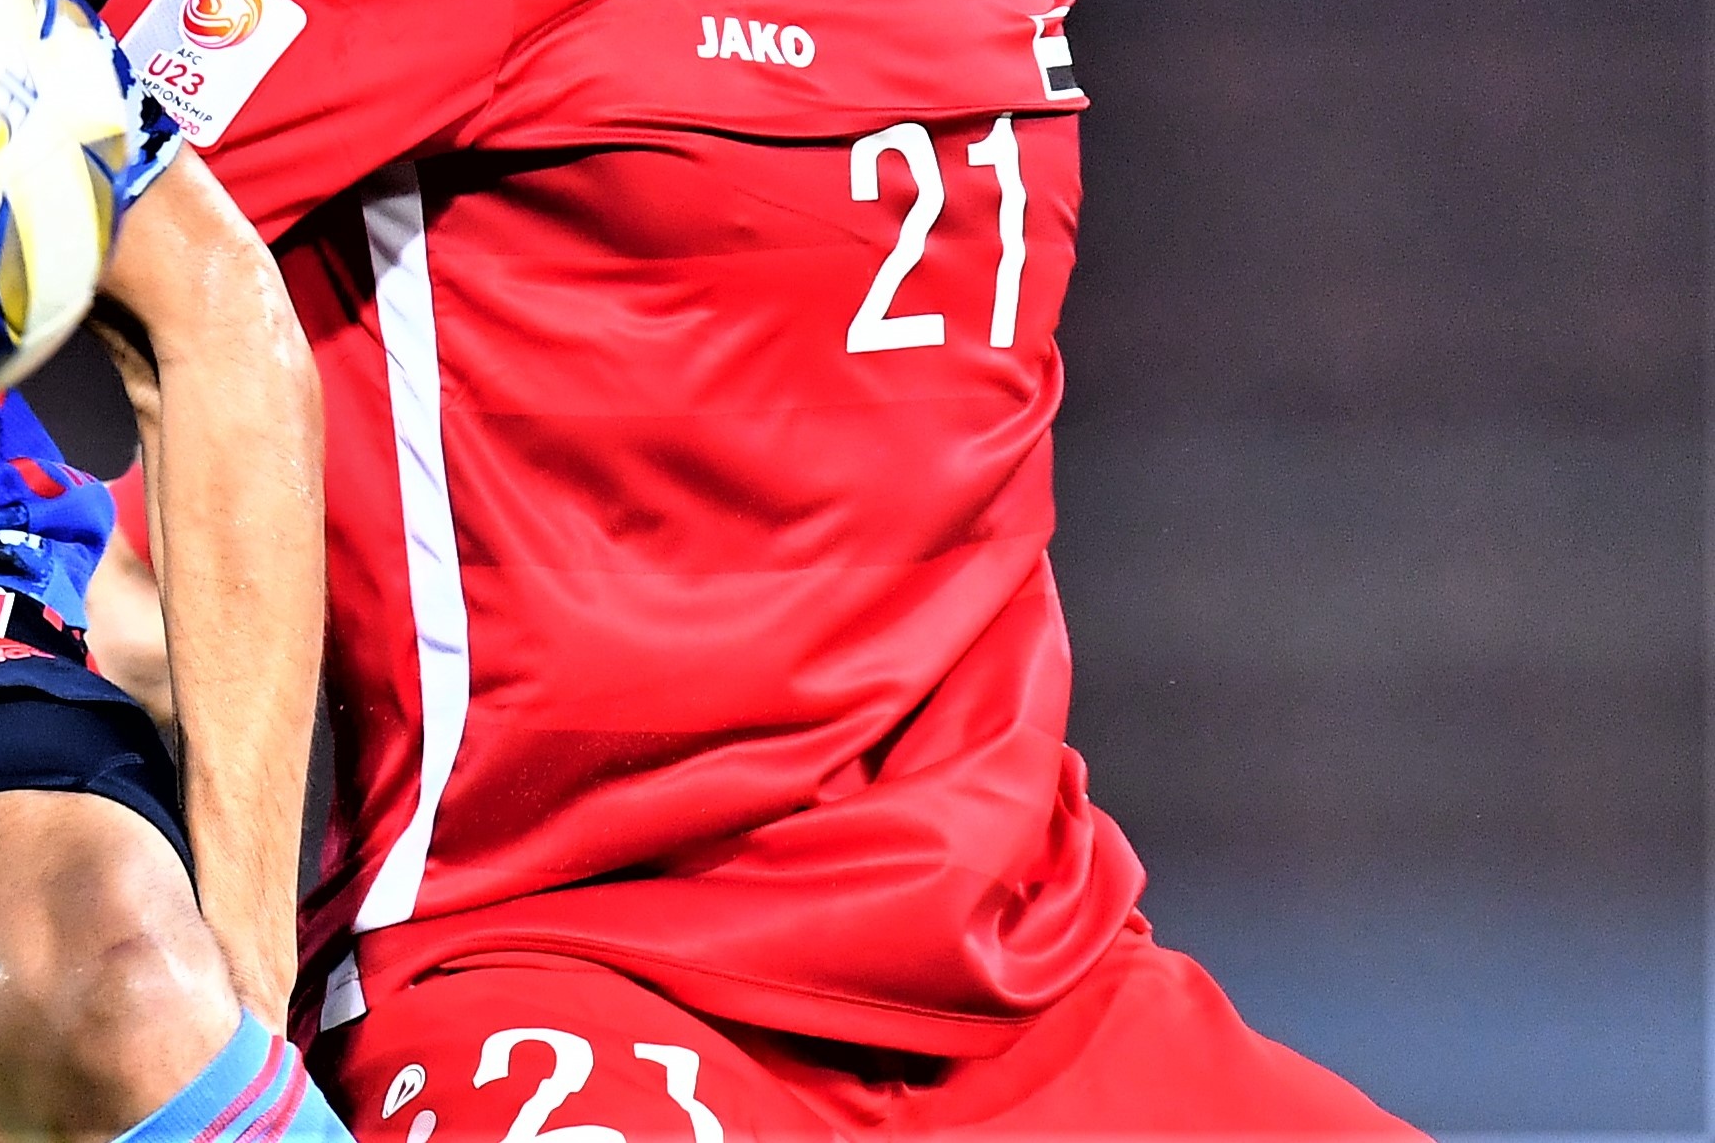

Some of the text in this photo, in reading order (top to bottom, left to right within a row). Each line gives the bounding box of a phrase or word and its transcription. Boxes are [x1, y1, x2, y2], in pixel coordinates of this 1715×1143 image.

[177, 47, 203, 66] AFC
[697, 16, 816, 68] JAKO
[148, 53, 205, 96] U23
[141, 77, 213, 122] MPIONSHIP
[846, 111, 1027, 354] 21
[472, 1027, 725, 1143] 21
